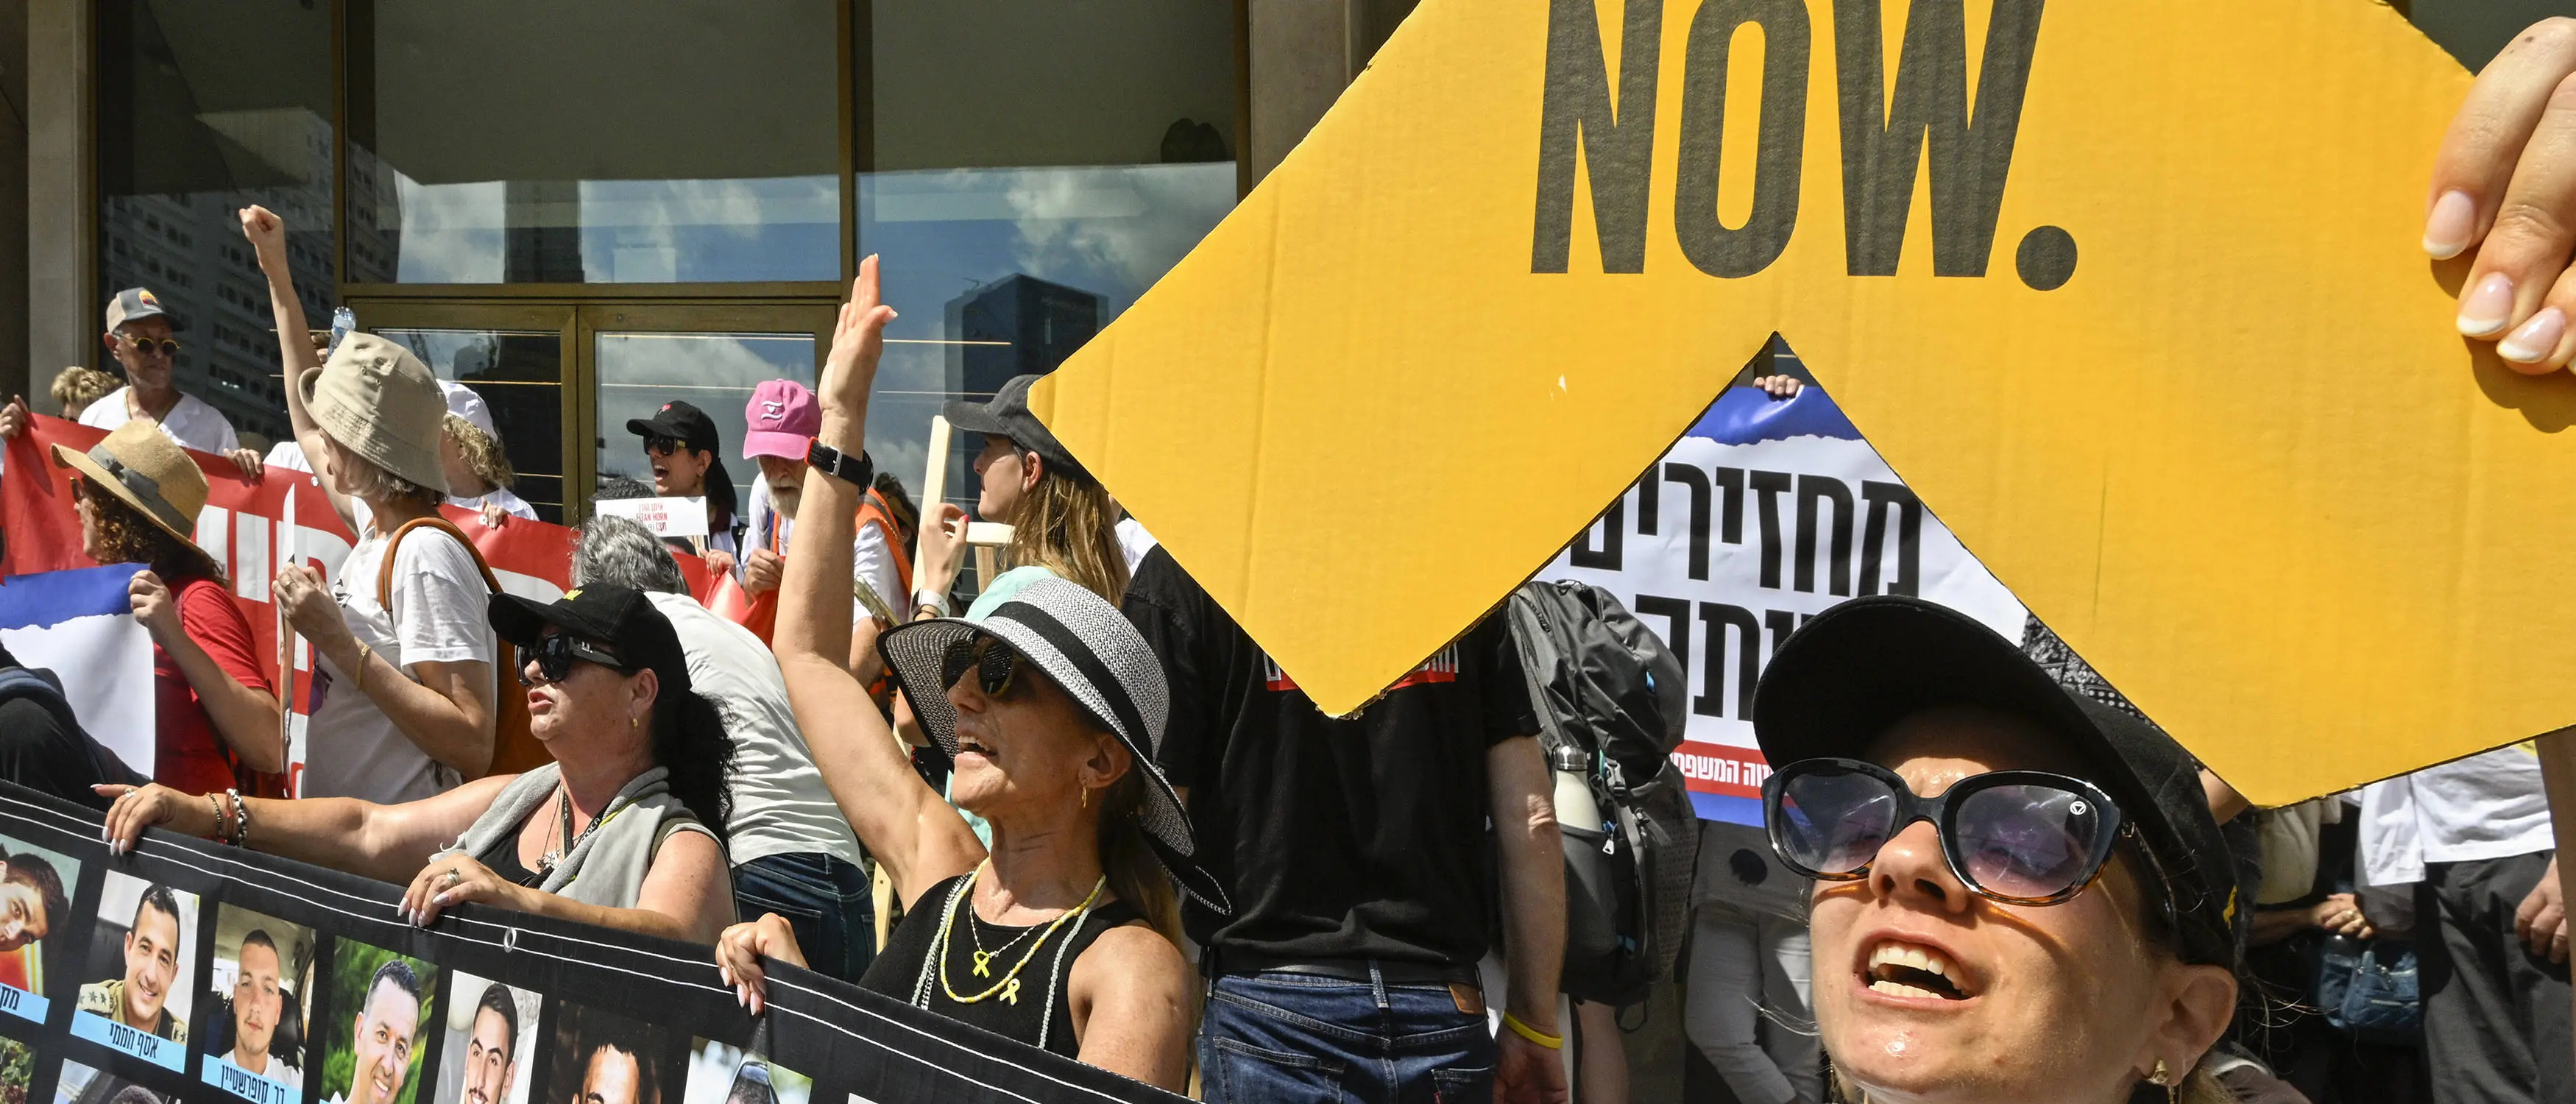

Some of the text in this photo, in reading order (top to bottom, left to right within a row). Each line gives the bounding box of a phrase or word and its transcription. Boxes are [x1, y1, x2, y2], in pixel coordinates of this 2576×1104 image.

[1531, 0, 2078, 291] NOW.
[1669, 751, 1739, 784] המשפח
[109, 1023, 160, 1058] אסף חממי
